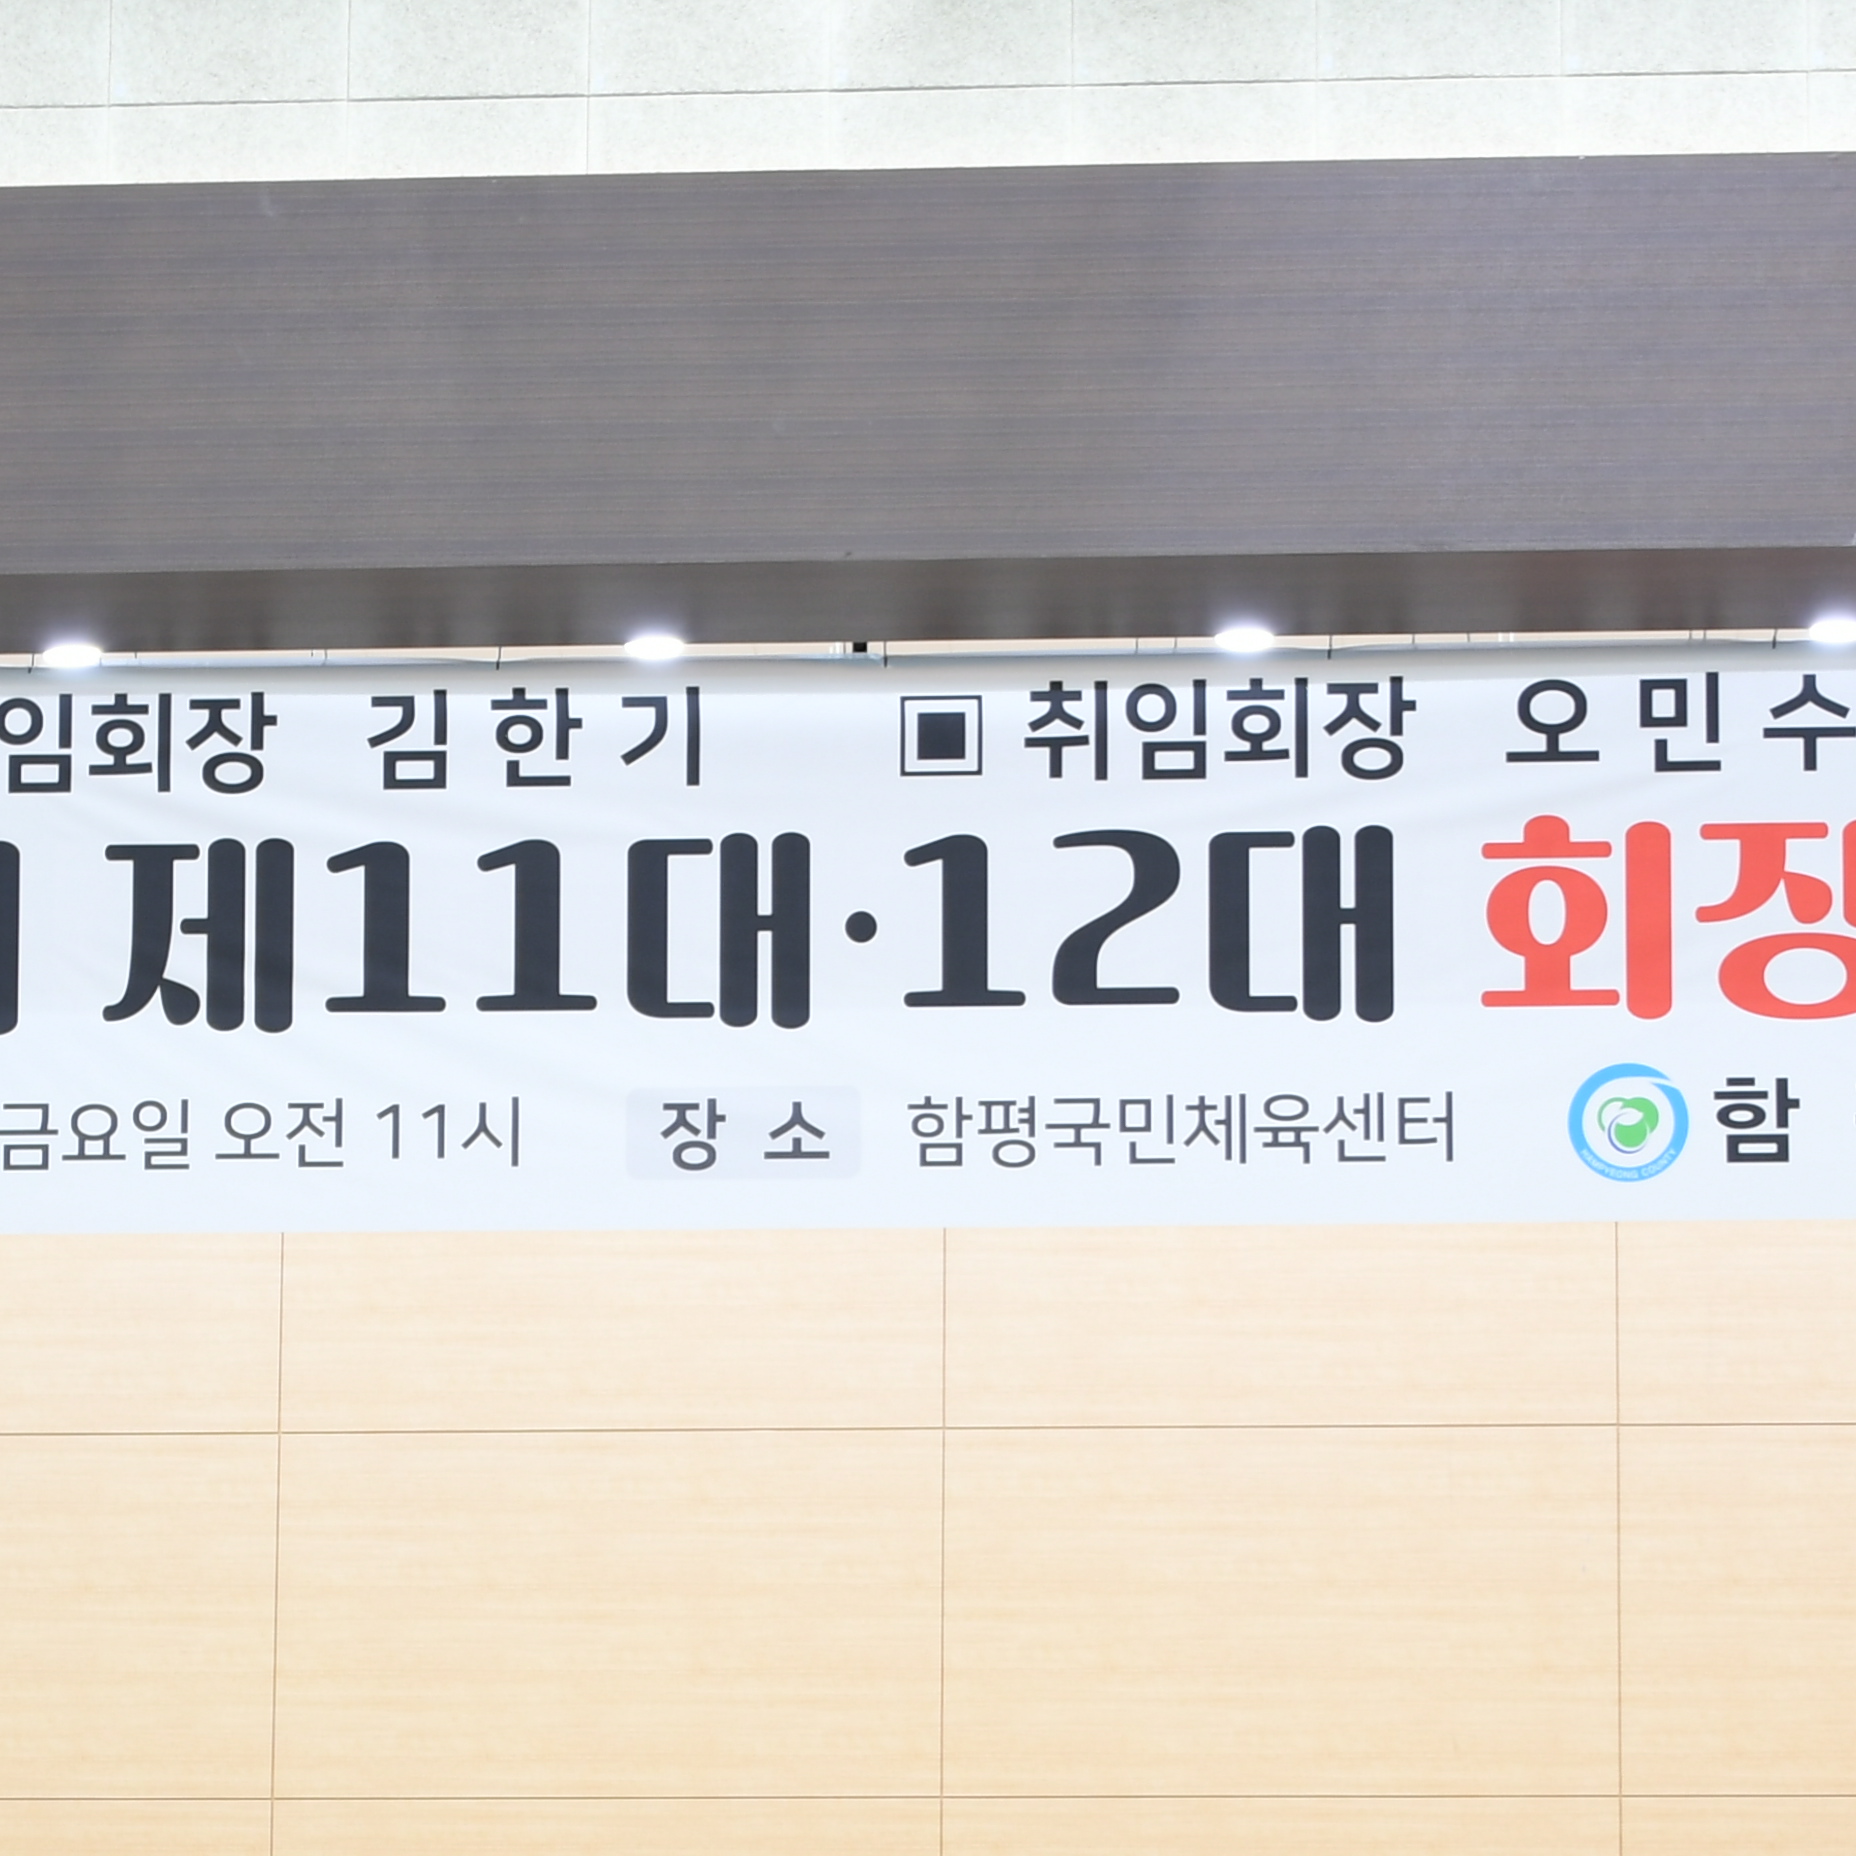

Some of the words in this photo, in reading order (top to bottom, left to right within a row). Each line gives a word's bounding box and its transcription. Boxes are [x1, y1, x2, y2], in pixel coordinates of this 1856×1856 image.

[1025, 676, 1416, 780] 취임회장
[215, 1098, 345, 1169] 오전
[377, 1097, 521, 1168] 11시
[907, 1092, 1455, 1168] 함평국민체육센터
